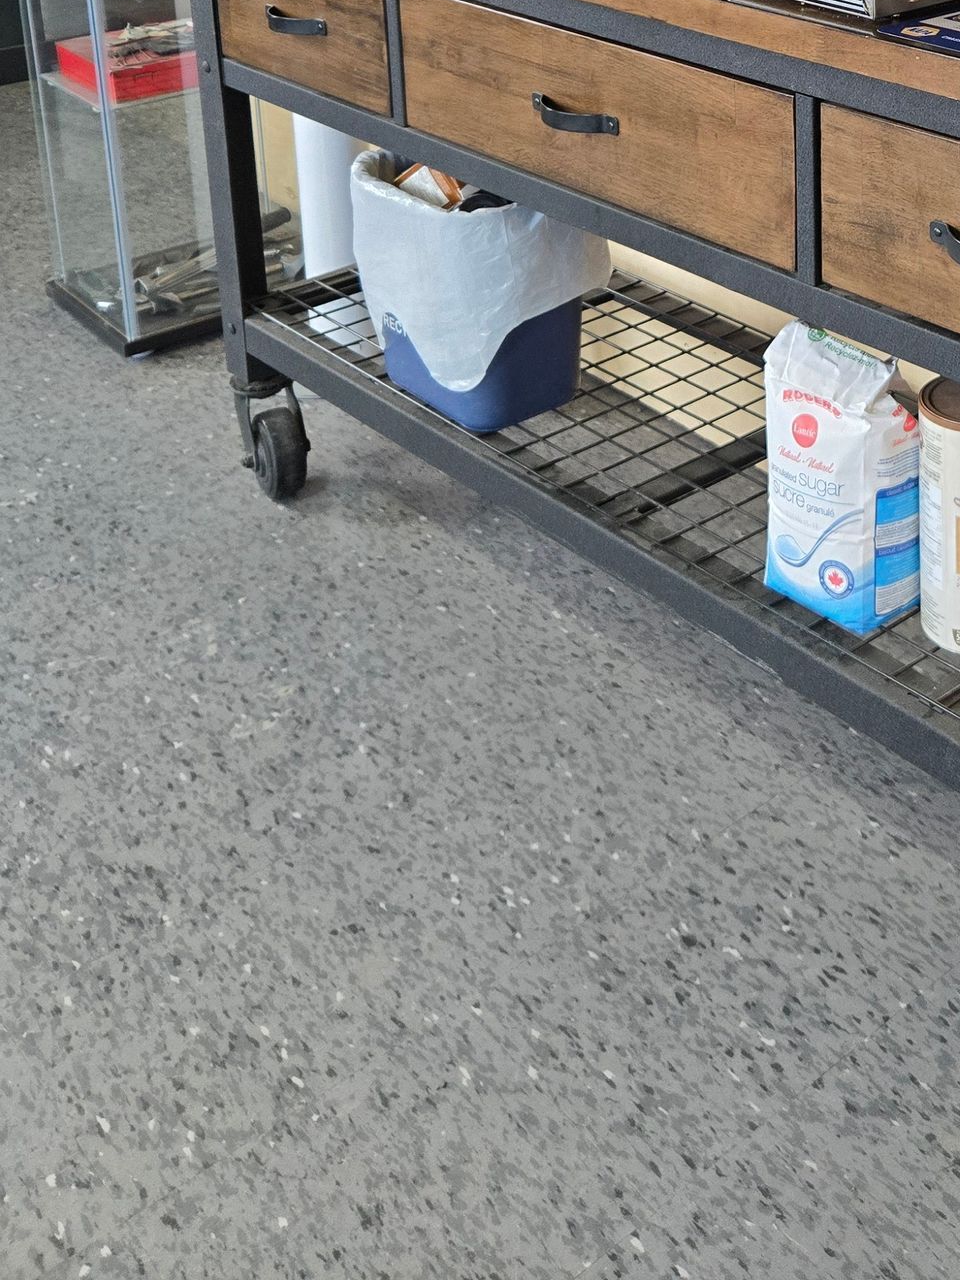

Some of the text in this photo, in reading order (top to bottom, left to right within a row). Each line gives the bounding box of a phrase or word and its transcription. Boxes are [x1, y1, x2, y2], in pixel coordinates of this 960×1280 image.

[782, 389, 842, 418] ROGERS
[772, 479, 835, 519] sucre granulé
